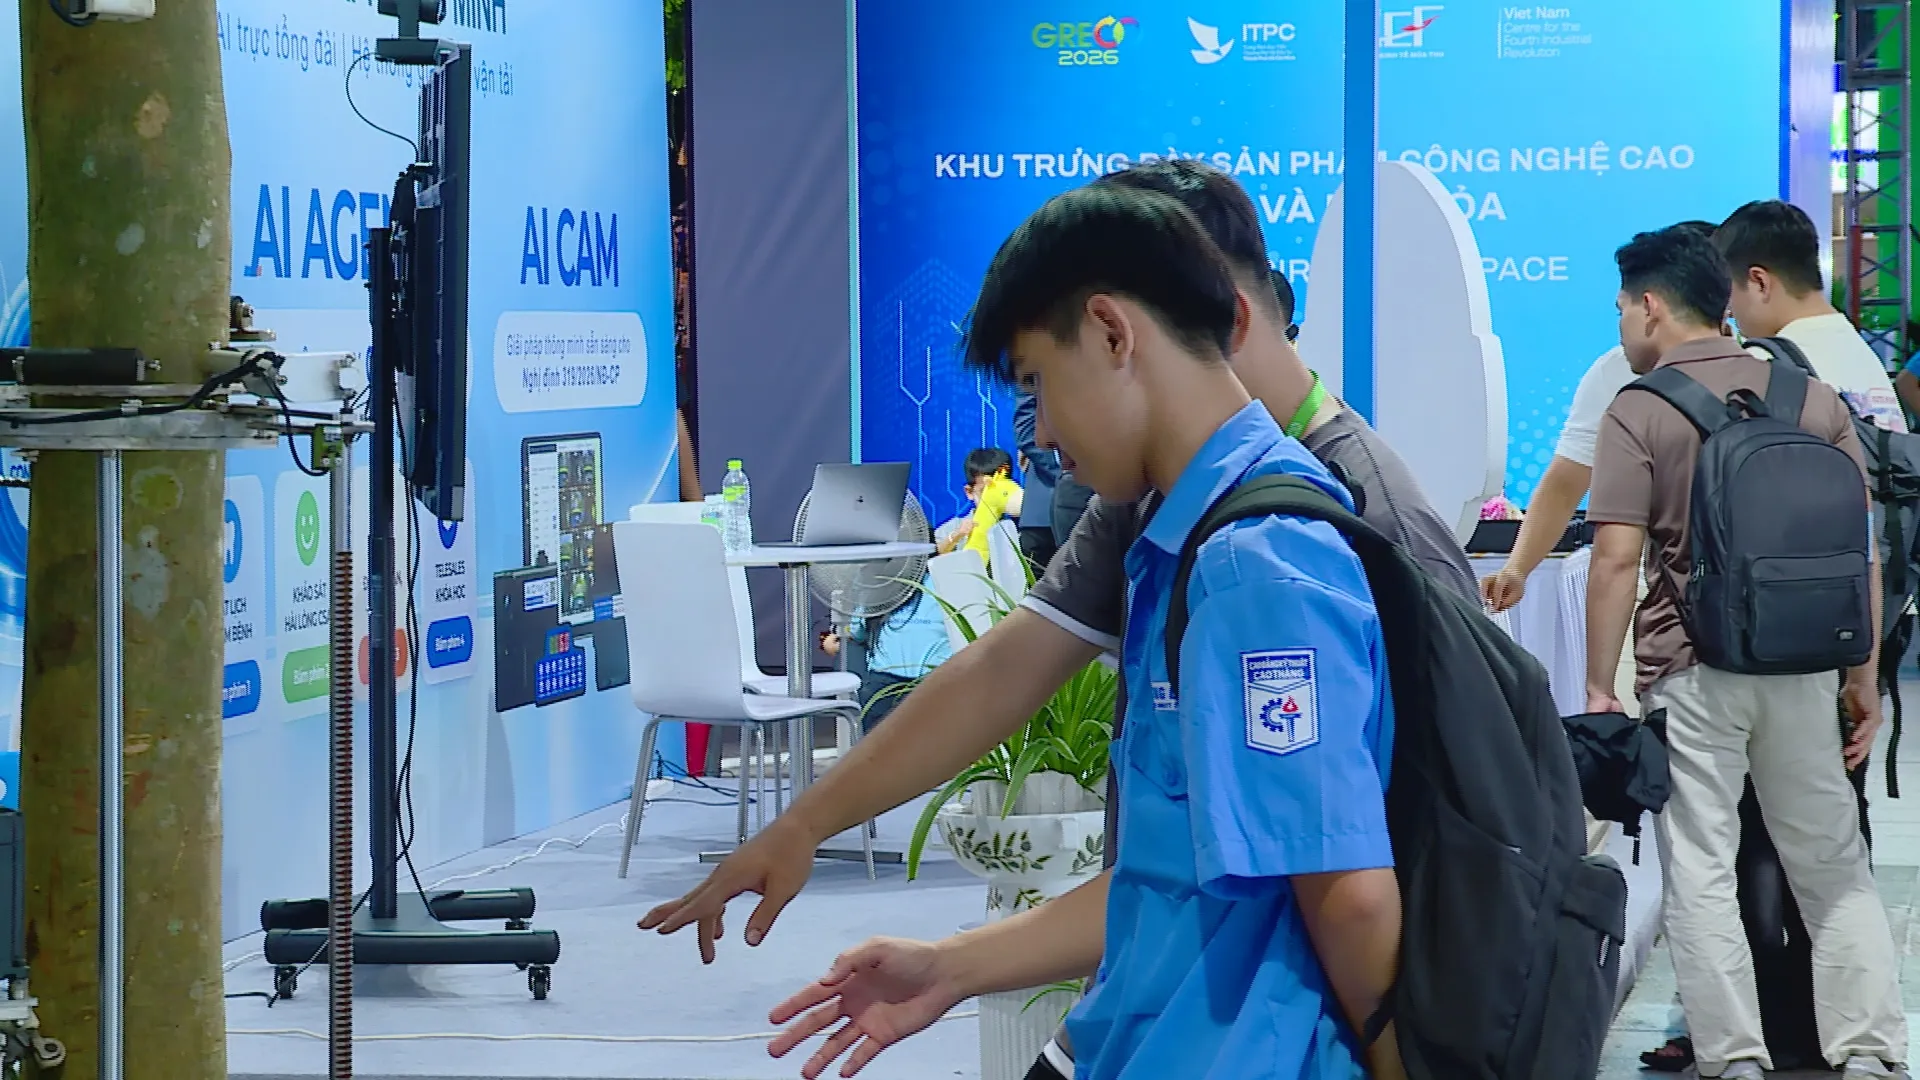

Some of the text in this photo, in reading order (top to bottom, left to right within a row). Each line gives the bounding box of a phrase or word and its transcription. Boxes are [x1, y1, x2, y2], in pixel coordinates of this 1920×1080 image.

[1503, 6, 1570, 19] Viet Nam
[1242, 23, 1296, 42] ITPC
[1504, 22, 1580, 33] Centre for the
[1504, 34, 1540, 46] Fourth
[237, 17, 270, 63] trực
[275, 14, 309, 72] tổng
[314, 30, 338, 67] đài
[473, 59, 495, 98] vận
[499, 62, 514, 96] tải
[1058, 50, 1119, 67] 2026
[935, 153, 1003, 178] KHU
[1012, 148, 1129, 178] TRƯNG
[1212, 146, 1280, 176] SẢN
[1399, 144, 1500, 172] CÔNG
[1510, 141, 1610, 176] NGHỆ
[1619, 144, 1696, 170] CAO
[1260, 187, 1315, 224] VÀ
[250, 184, 391, 281] AI AGE
[520, 206, 619, 287] AI CAM
[1482, 256, 1569, 281] PACE
[435, 560, 465, 578] TELESALES
[293, 579, 327, 603] KHẢO SÁT
[1253, 671, 1272, 681] CAO
